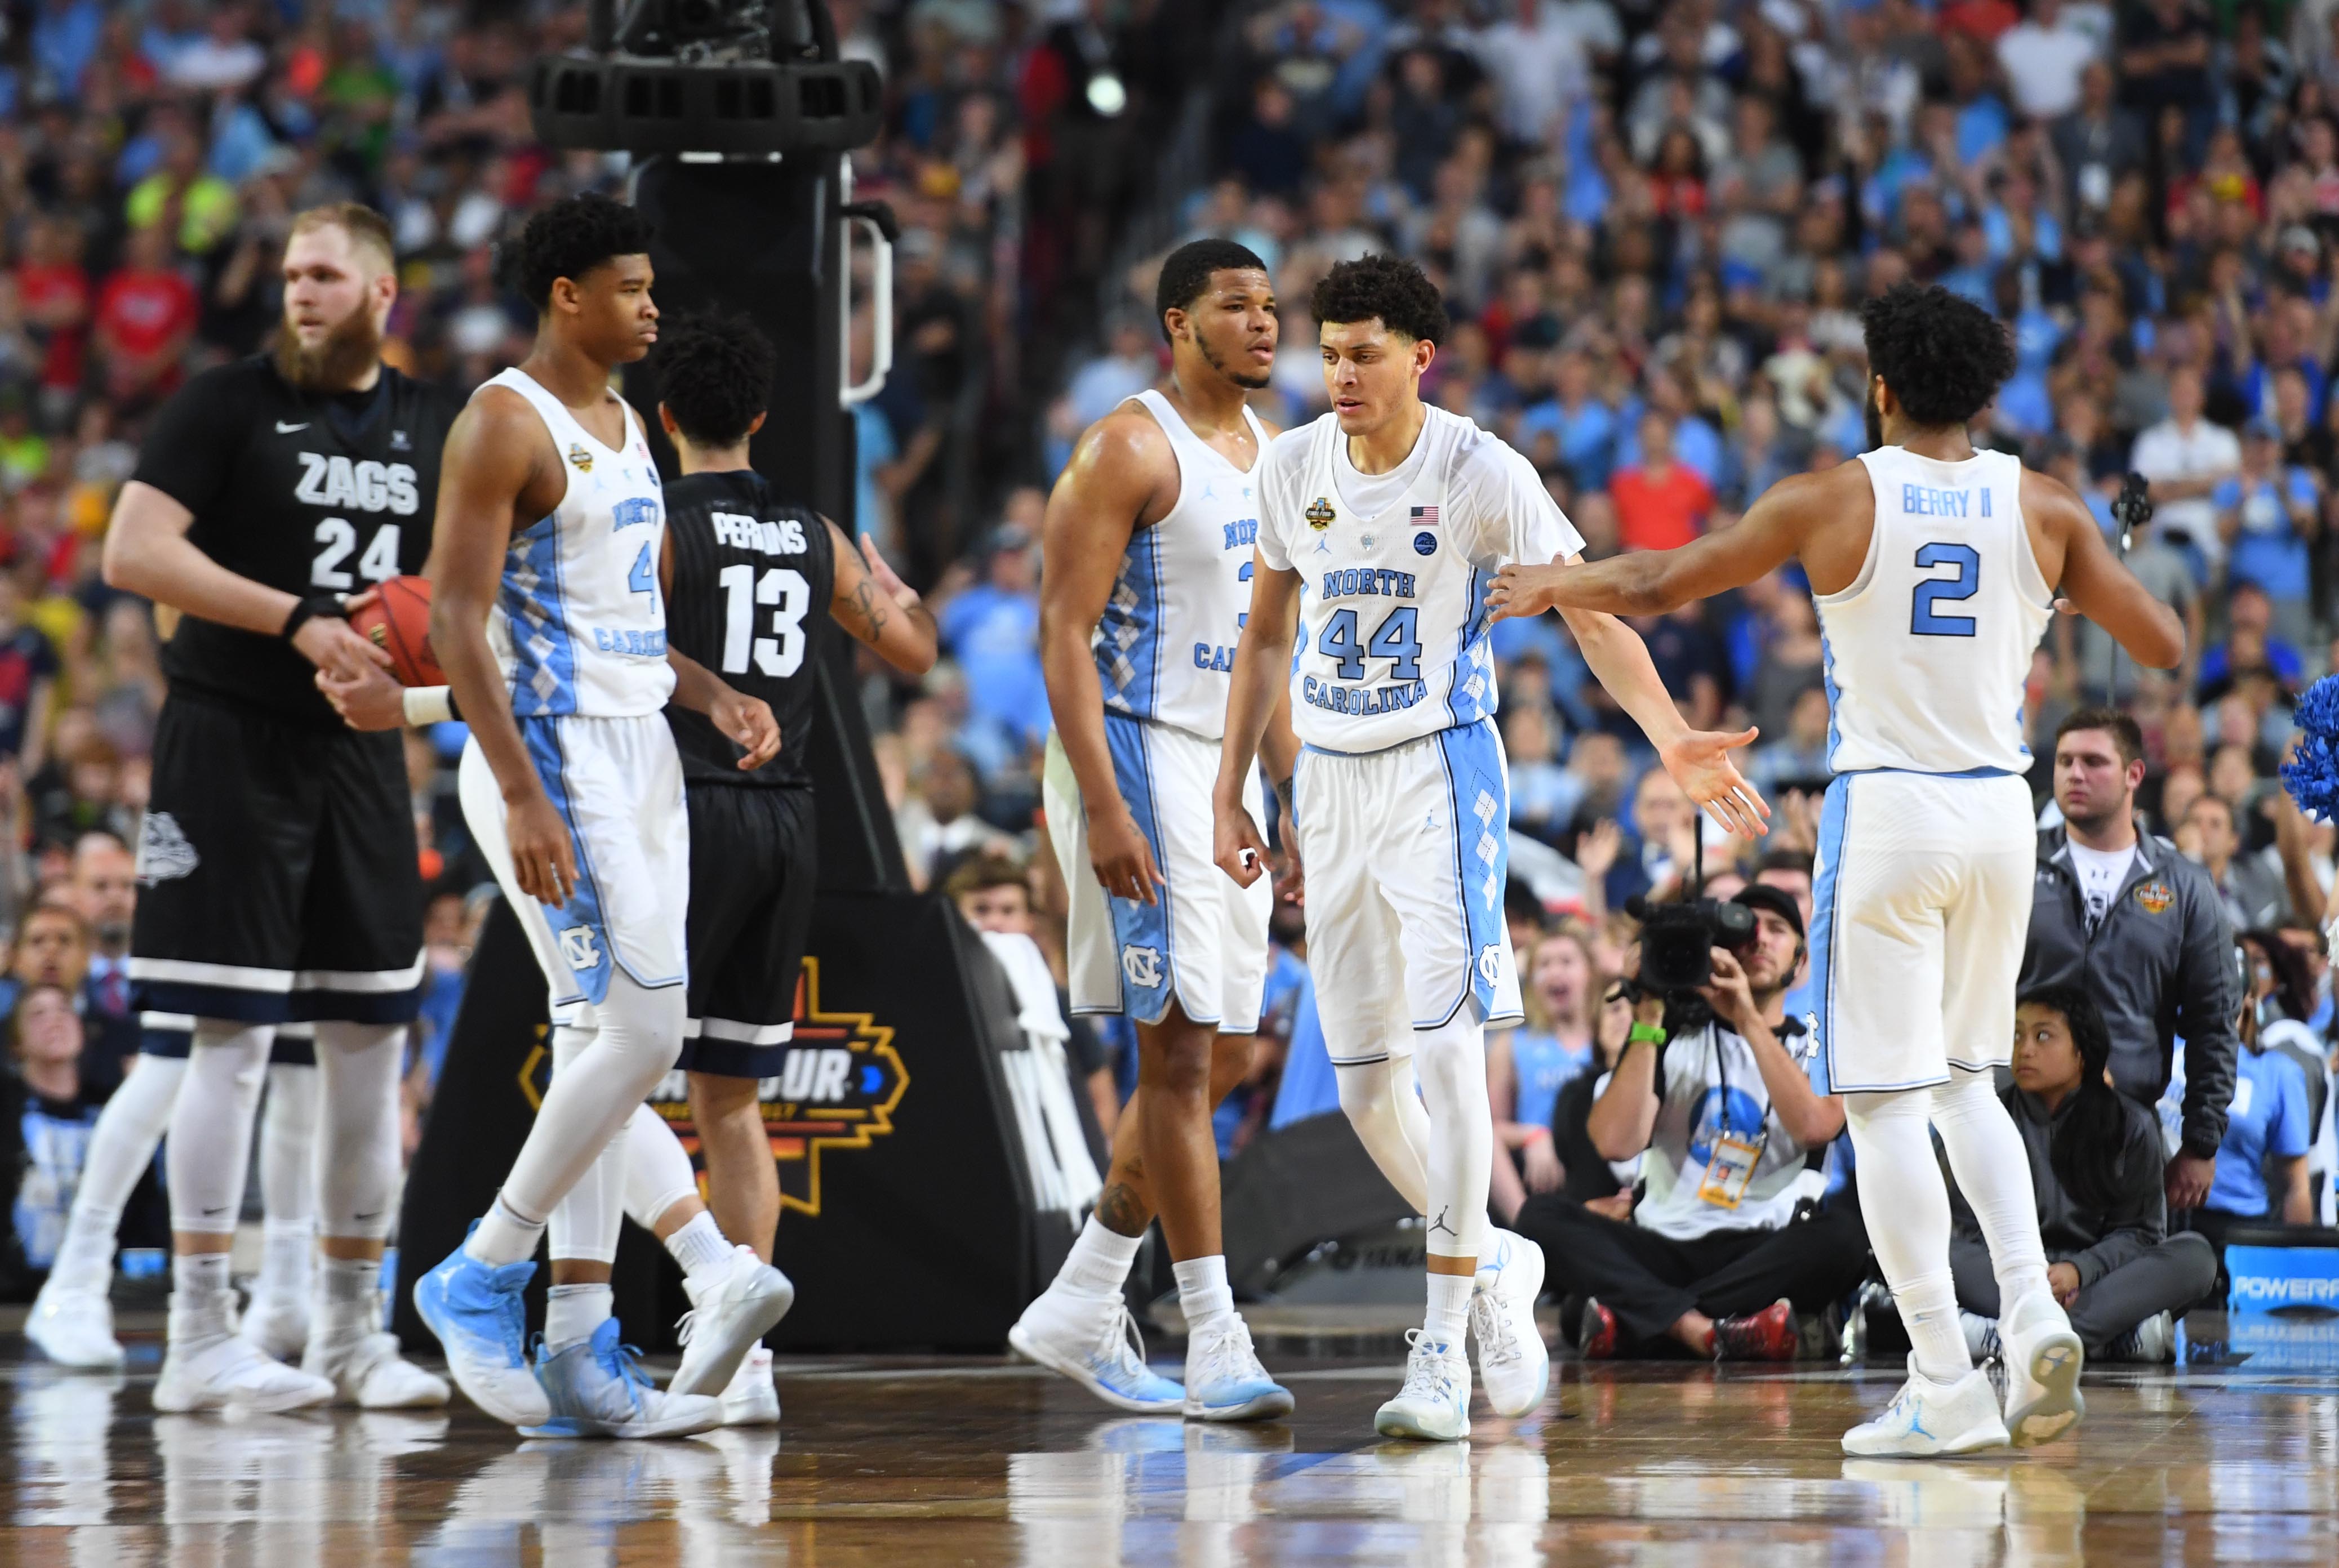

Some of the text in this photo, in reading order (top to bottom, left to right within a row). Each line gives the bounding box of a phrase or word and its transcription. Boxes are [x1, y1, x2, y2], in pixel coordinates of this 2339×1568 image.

[294, 451, 419, 515] ZAGS
[1902, 483, 1993, 518] BERRY II
[310, 517, 401, 590] 24
[1323, 568, 1416, 600] NORTH
[719, 564, 810, 678] 13
[1910, 542, 1980, 637] 2
[1319, 607, 1422, 680] 44
[1303, 675, 1428, 716] CAROLINA
